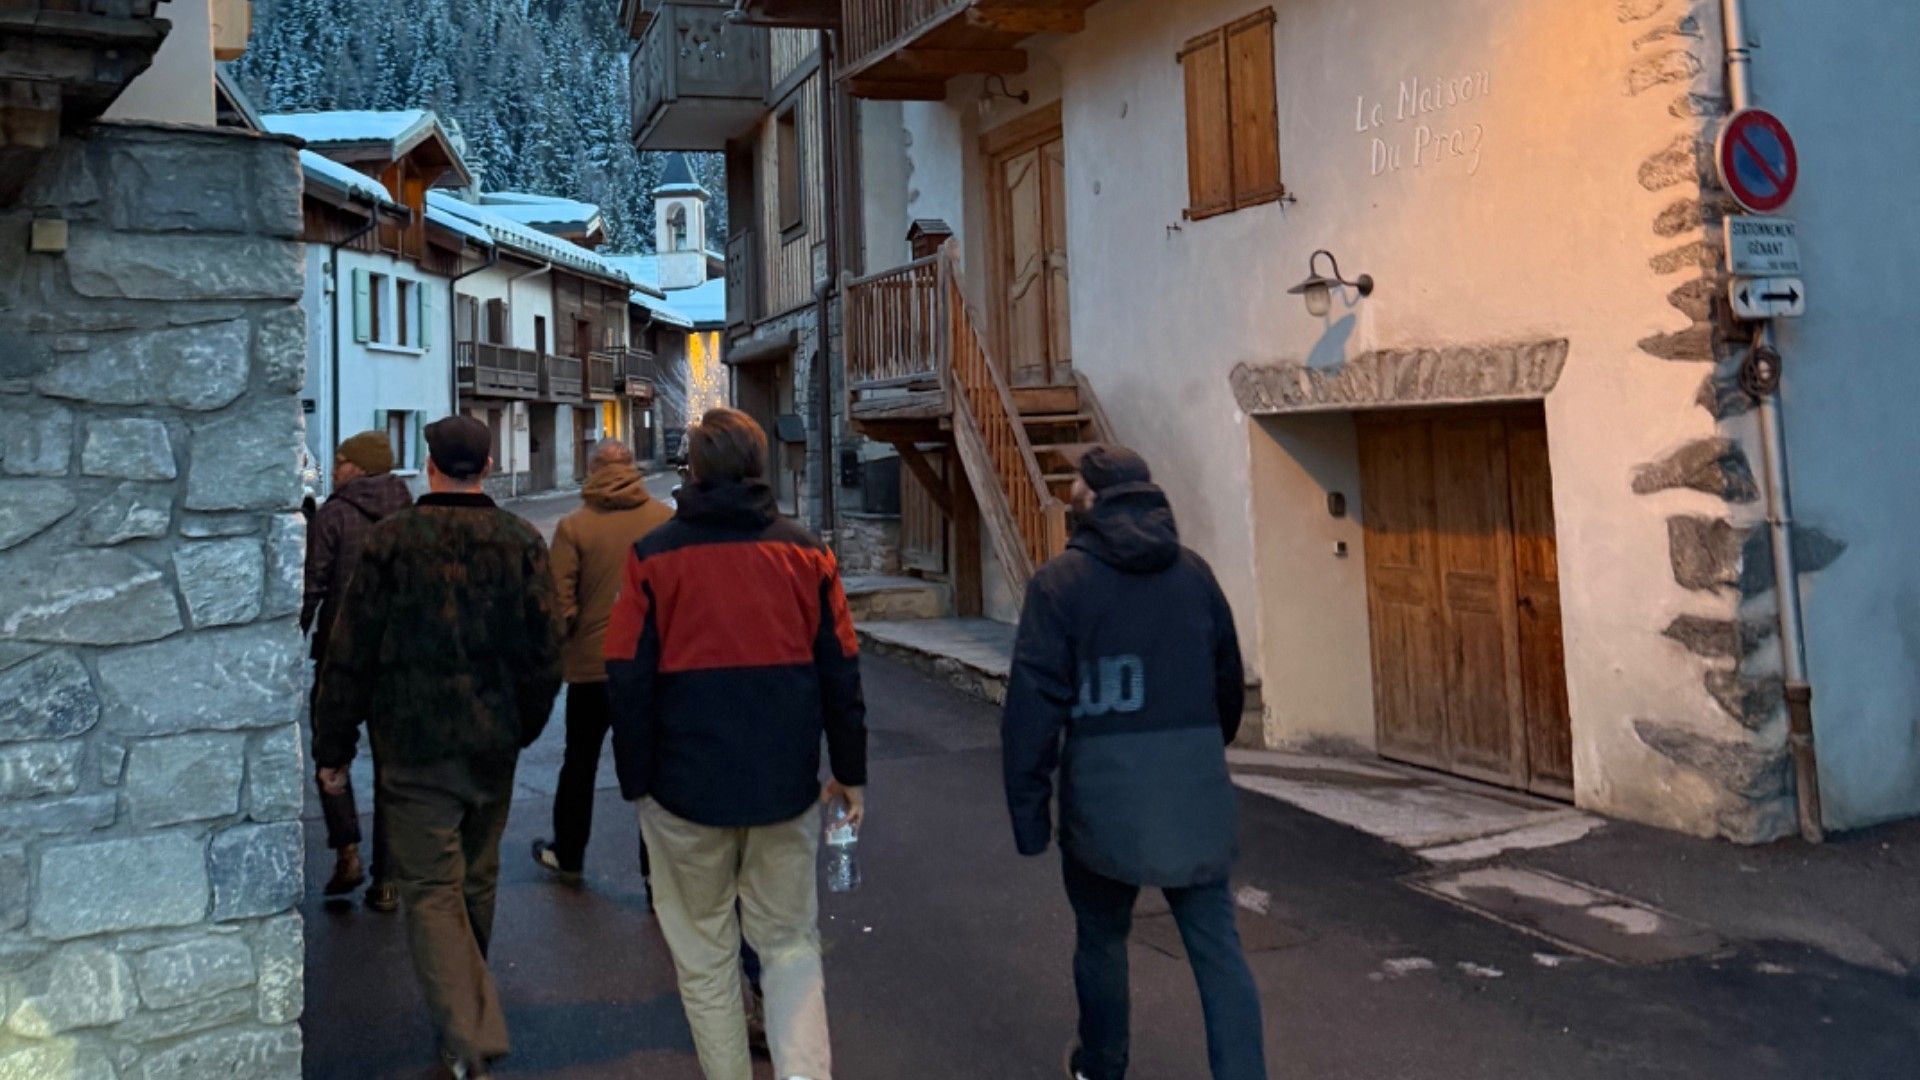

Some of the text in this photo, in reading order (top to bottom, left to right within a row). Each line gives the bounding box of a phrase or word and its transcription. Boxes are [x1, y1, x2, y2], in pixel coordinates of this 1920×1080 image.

[1355, 71, 1490, 132] La Maison
[1371, 138, 1401, 176] Du
[1732, 222, 1796, 237] STATIONNEMENT
